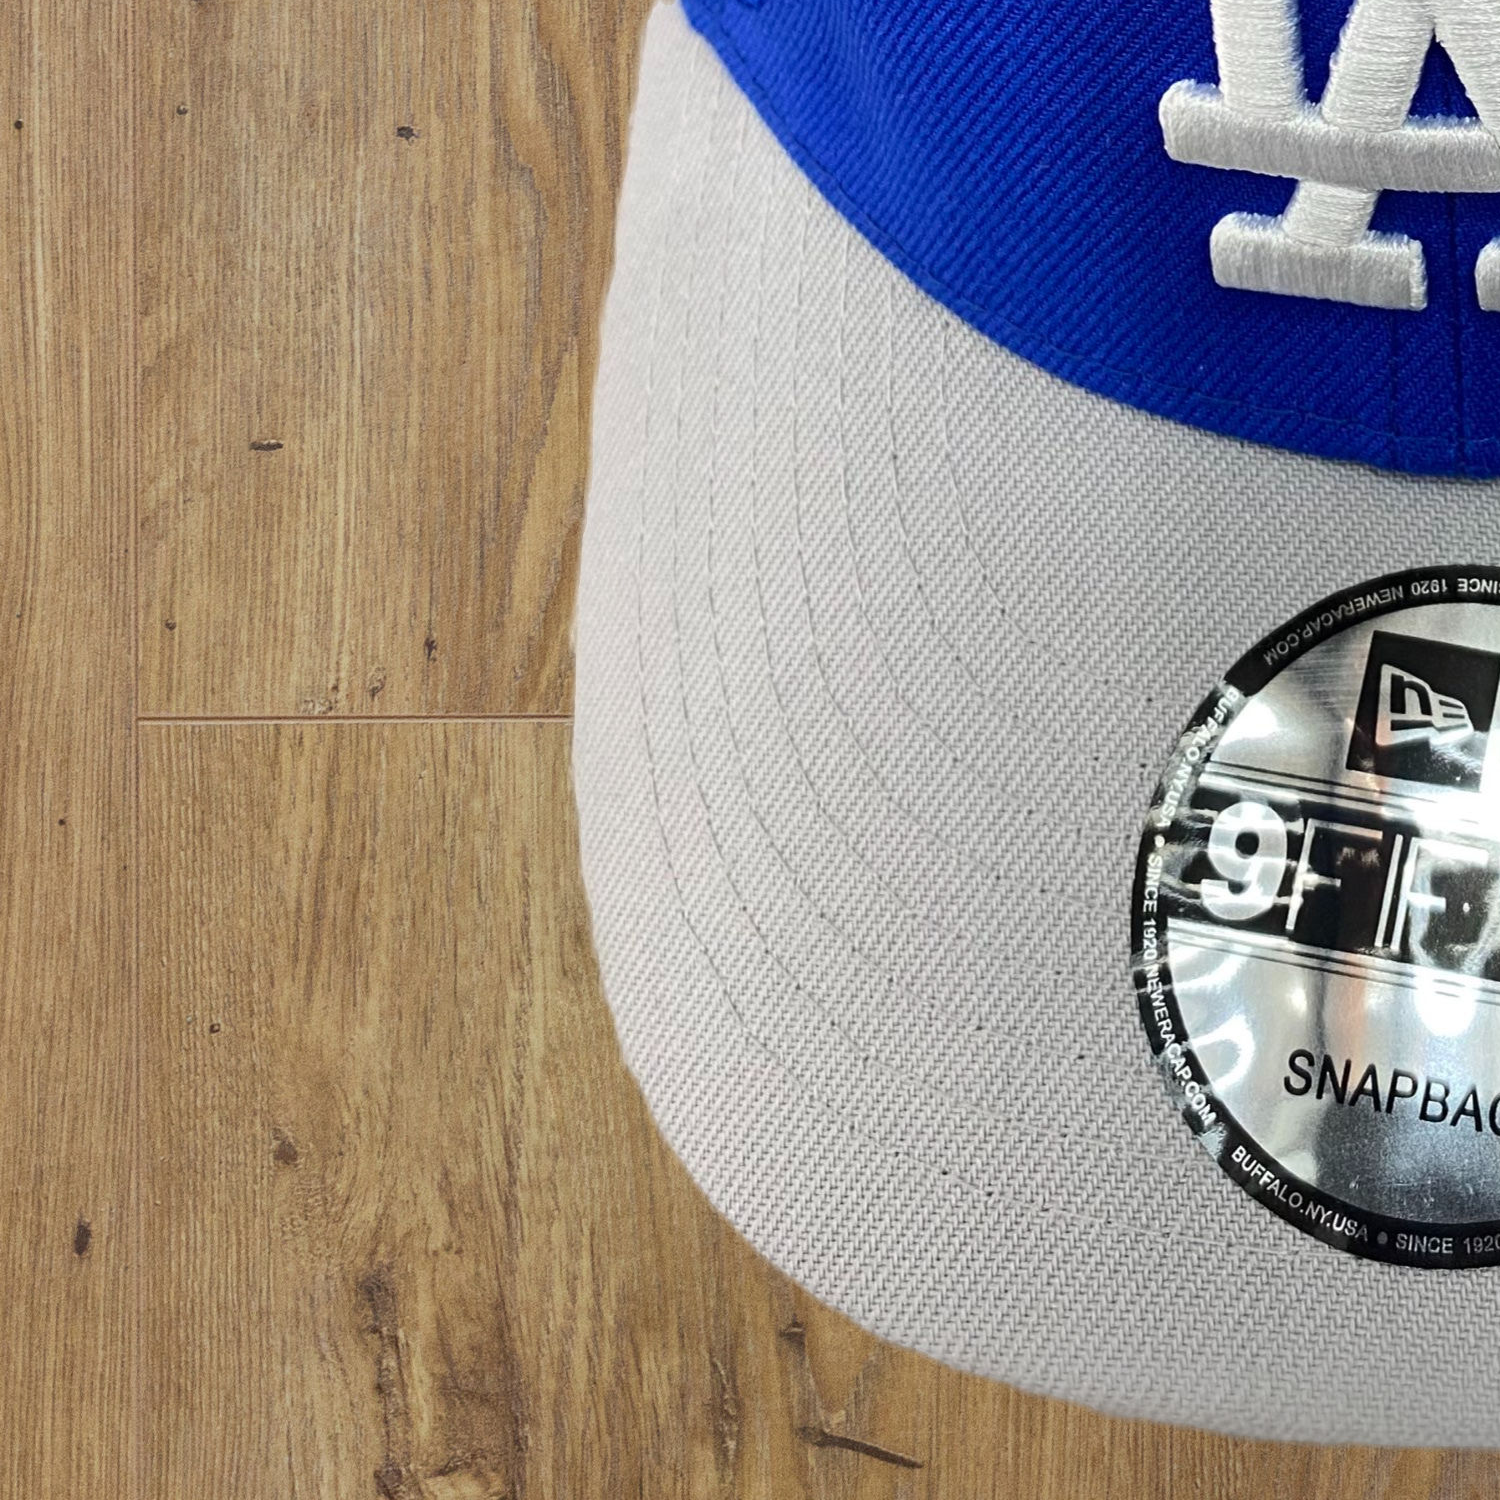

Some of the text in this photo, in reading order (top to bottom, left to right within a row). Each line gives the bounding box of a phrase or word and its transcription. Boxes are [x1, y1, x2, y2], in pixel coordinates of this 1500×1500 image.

[1262, 585, 1404, 667] NEWERACAP.COM
[1410, 578, 1448, 596] 1920
[1142, 684, 1241, 1126] BUFFALO.NY.USA SINCE 1920 NEWERACAP.COM
[1230, 1145, 1369, 1242] BUFFALO.NY.USA
[1394, 1232, 1454, 1254] SINCE
